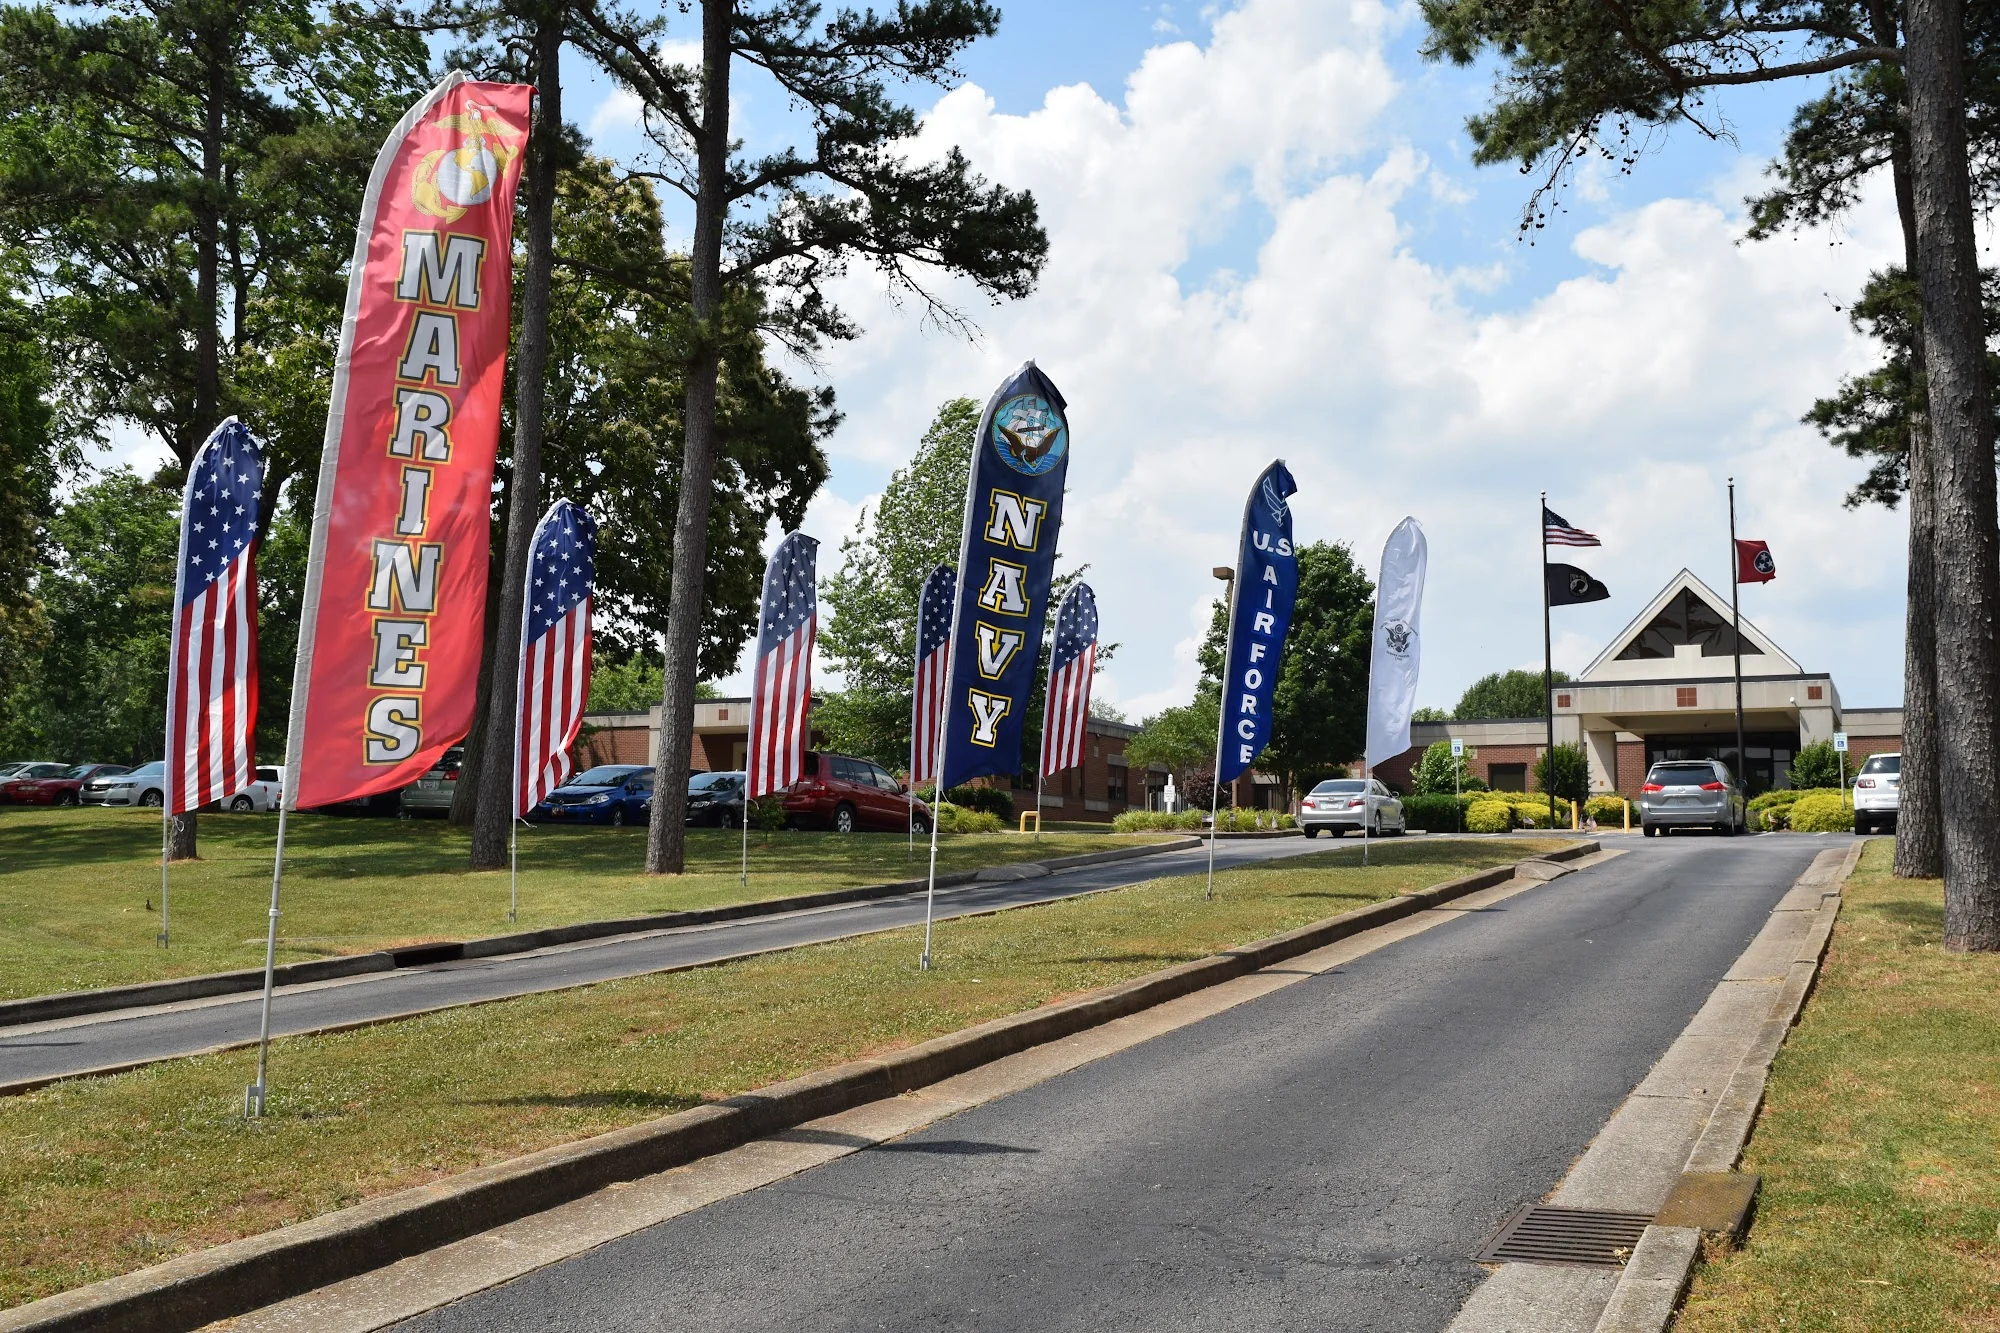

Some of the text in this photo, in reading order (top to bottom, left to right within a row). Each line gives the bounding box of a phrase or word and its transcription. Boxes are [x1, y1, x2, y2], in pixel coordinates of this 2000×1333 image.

[362, 229, 487, 766] MARINES
[968, 489, 1047, 748] NAVY
[1253, 565, 1278, 636] AIR
[1237, 642, 1268, 763] FORCE
